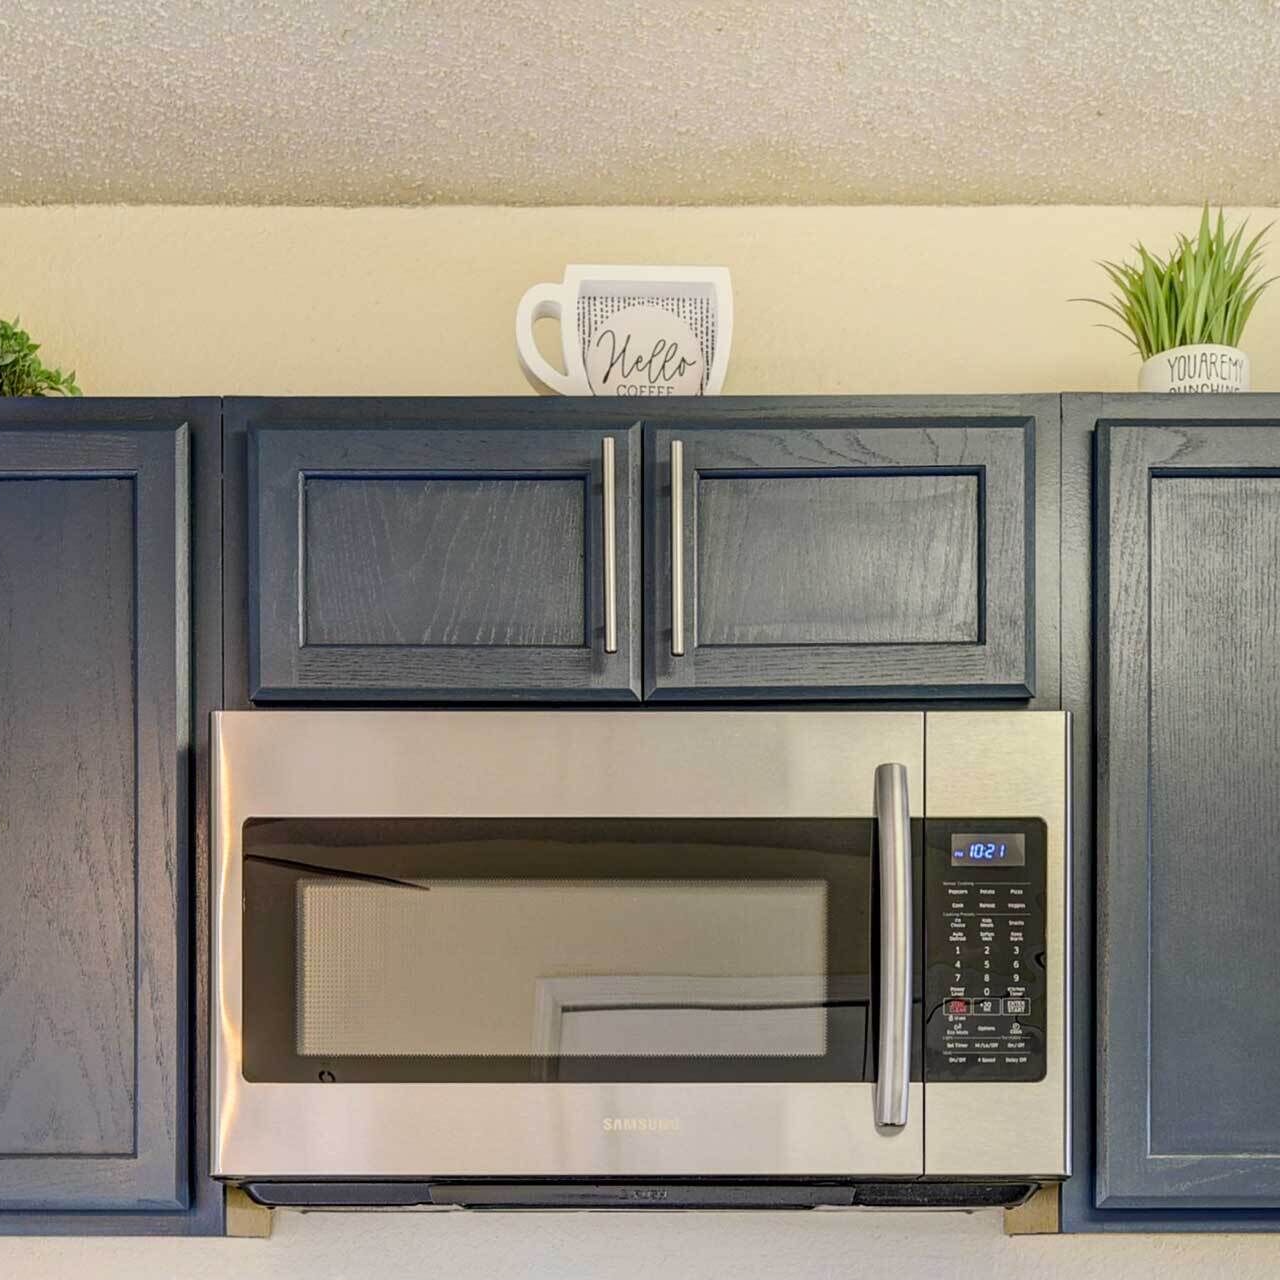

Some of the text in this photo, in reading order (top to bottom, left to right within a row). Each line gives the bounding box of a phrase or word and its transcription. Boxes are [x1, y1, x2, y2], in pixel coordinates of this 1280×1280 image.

[596, 329, 697, 384] Hello
[1168, 354, 1197, 382] YOU
[1198, 352, 1227, 380] ARE
[969, 843, 1005, 859] 10:21
[955, 946, 961, 955] 1
[984, 946, 990, 955] 2
[1013, 946, 1020, 955] 3
[955, 960, 961, 969] 4
[984, 960, 990, 969] 5
[1013, 960, 1020, 969] 6
[955, 974, 961, 982] 7
[984, 974, 990, 982] 8
[1013, 974, 1020, 982] 9
